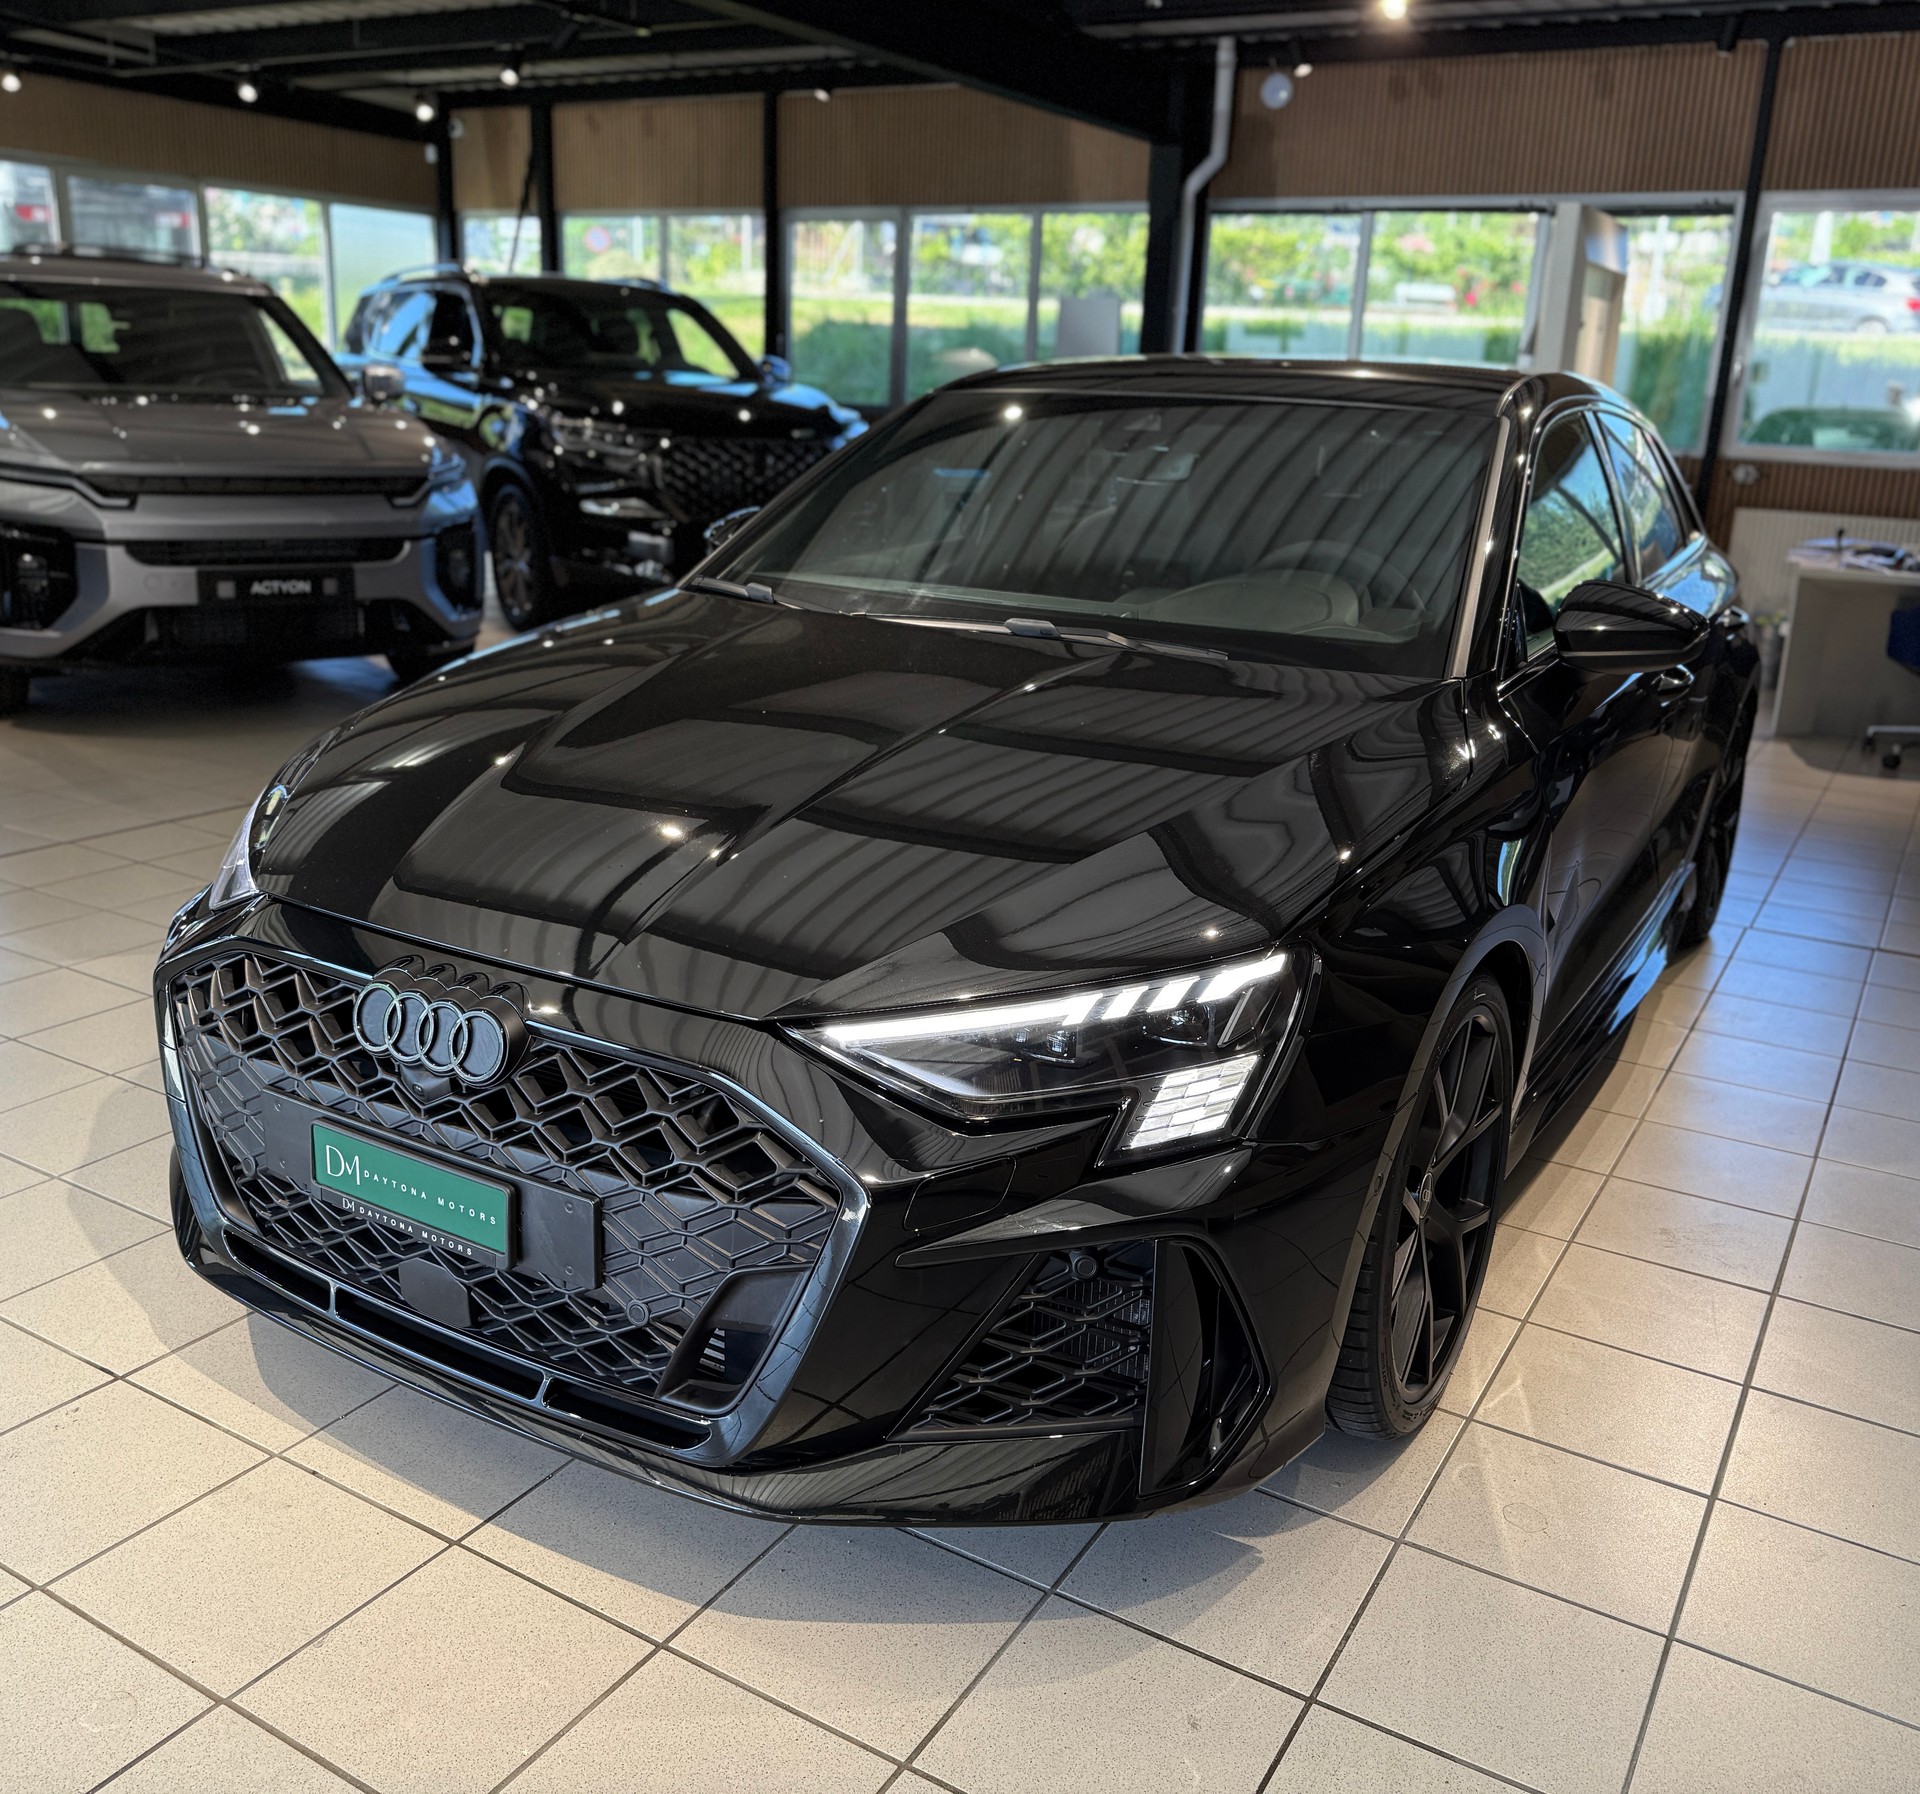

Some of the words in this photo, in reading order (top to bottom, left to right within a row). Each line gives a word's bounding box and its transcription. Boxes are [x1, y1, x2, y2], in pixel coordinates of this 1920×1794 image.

[250, 579, 312, 596] ACTYON
[364, 1169, 428, 1200] DAYTONA
[437, 1196, 497, 1226] MOTORS
[359, 1206, 413, 1234] DAYTONA
[422, 1230, 473, 1256] MOTORS
